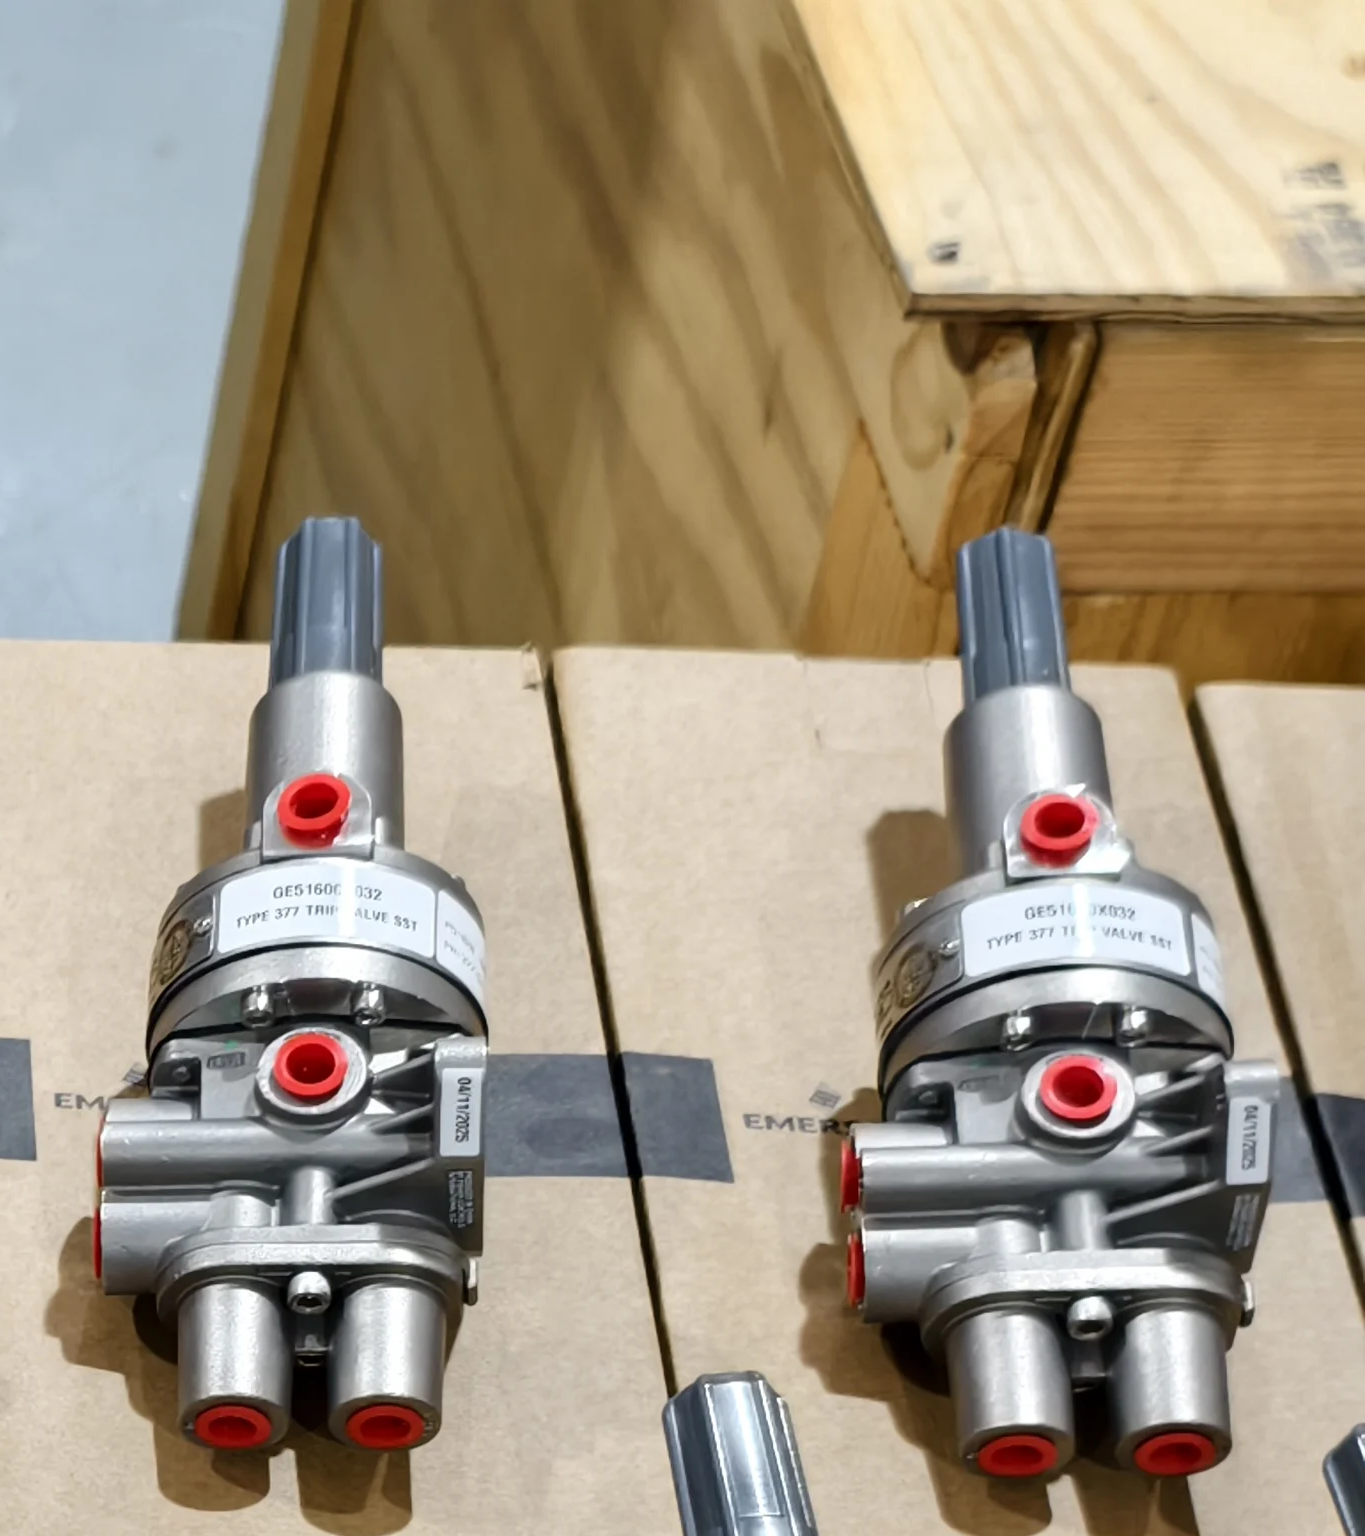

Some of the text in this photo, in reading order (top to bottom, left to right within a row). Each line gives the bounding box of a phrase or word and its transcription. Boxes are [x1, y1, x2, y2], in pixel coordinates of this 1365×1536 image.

[272, 883, 383, 901] GE51600032
[236, 909, 270, 929] TYPE
[274, 906, 300, 920] 377
[353, 907, 389, 924] ALVE
[393, 914, 419, 932] SST
[986, 931, 1022, 950] TYPE
[1028, 926, 1055, 941] 377
[1101, 925, 1146, 943] VALVE
[453, 1075, 473, 1145] 04/11/2025
